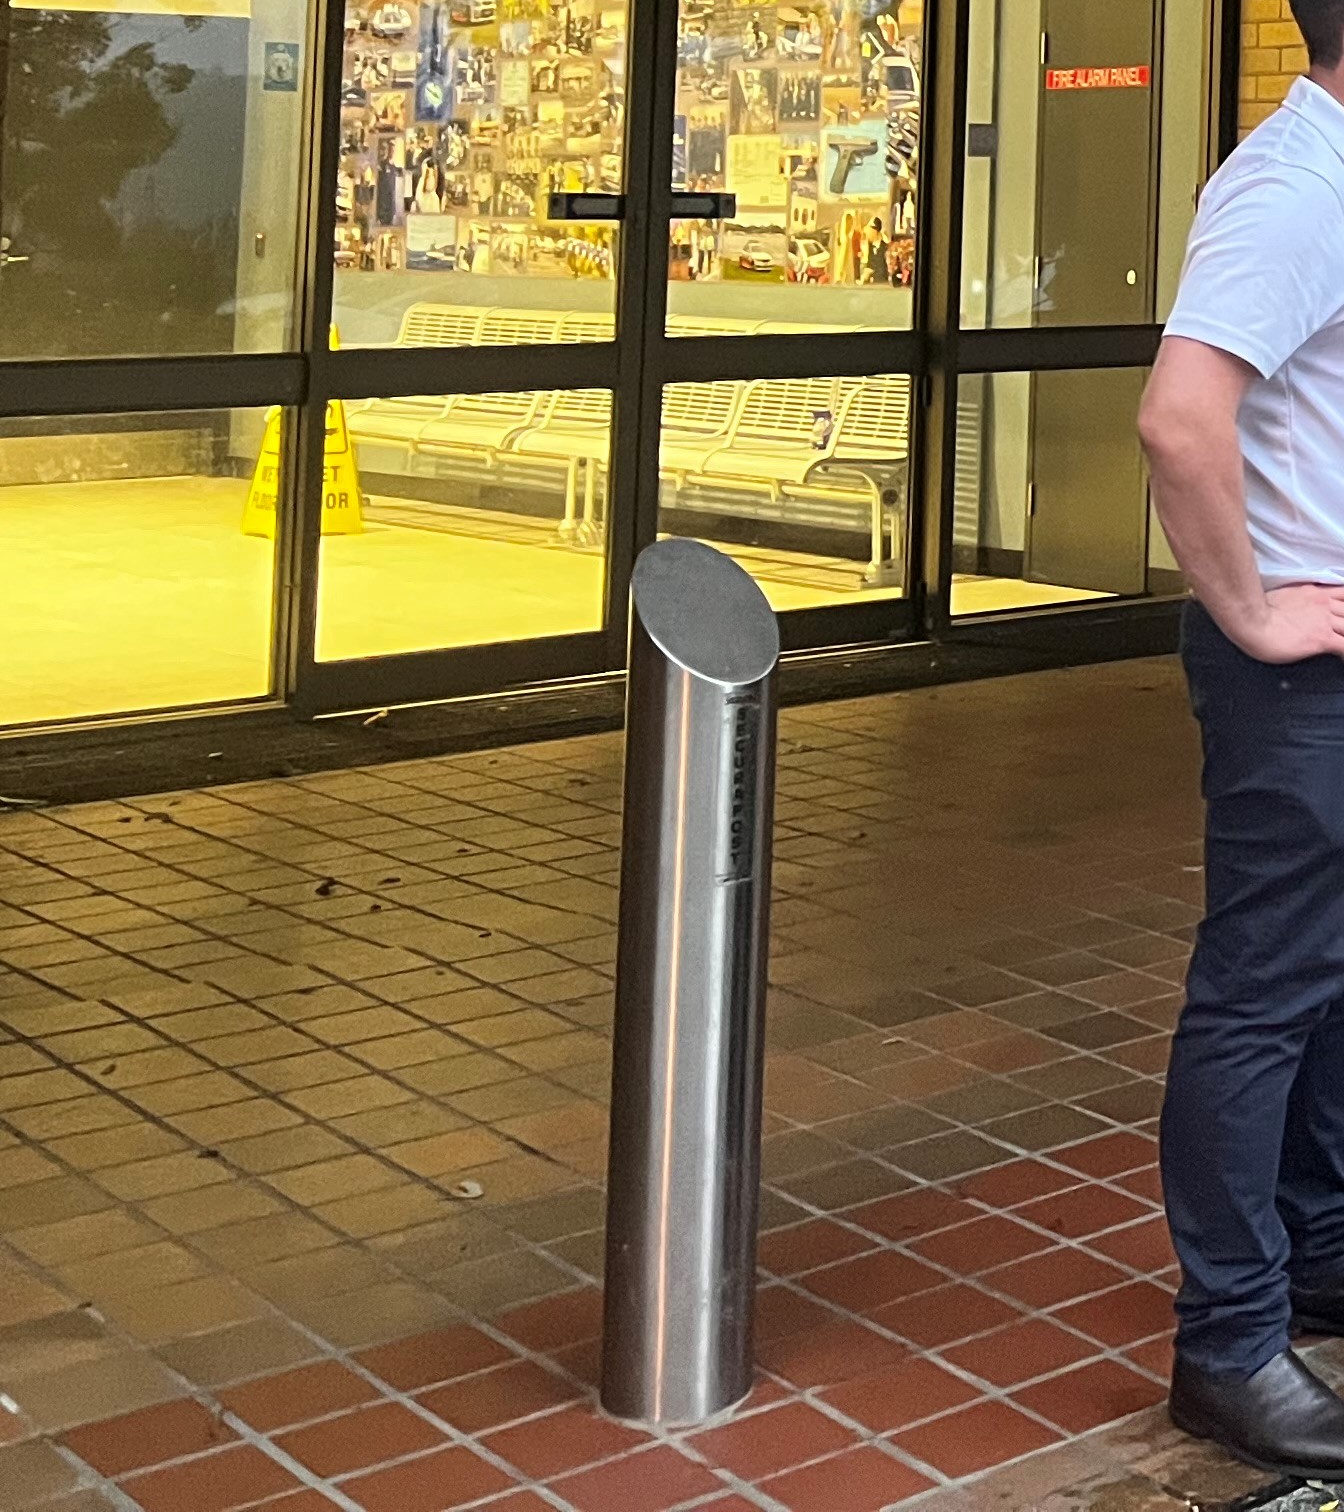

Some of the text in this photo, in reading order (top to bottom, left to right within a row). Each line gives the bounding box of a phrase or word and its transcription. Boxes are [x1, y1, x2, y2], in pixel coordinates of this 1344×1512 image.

[1053, 67, 1142, 88] FIRE ALARM PANEL
